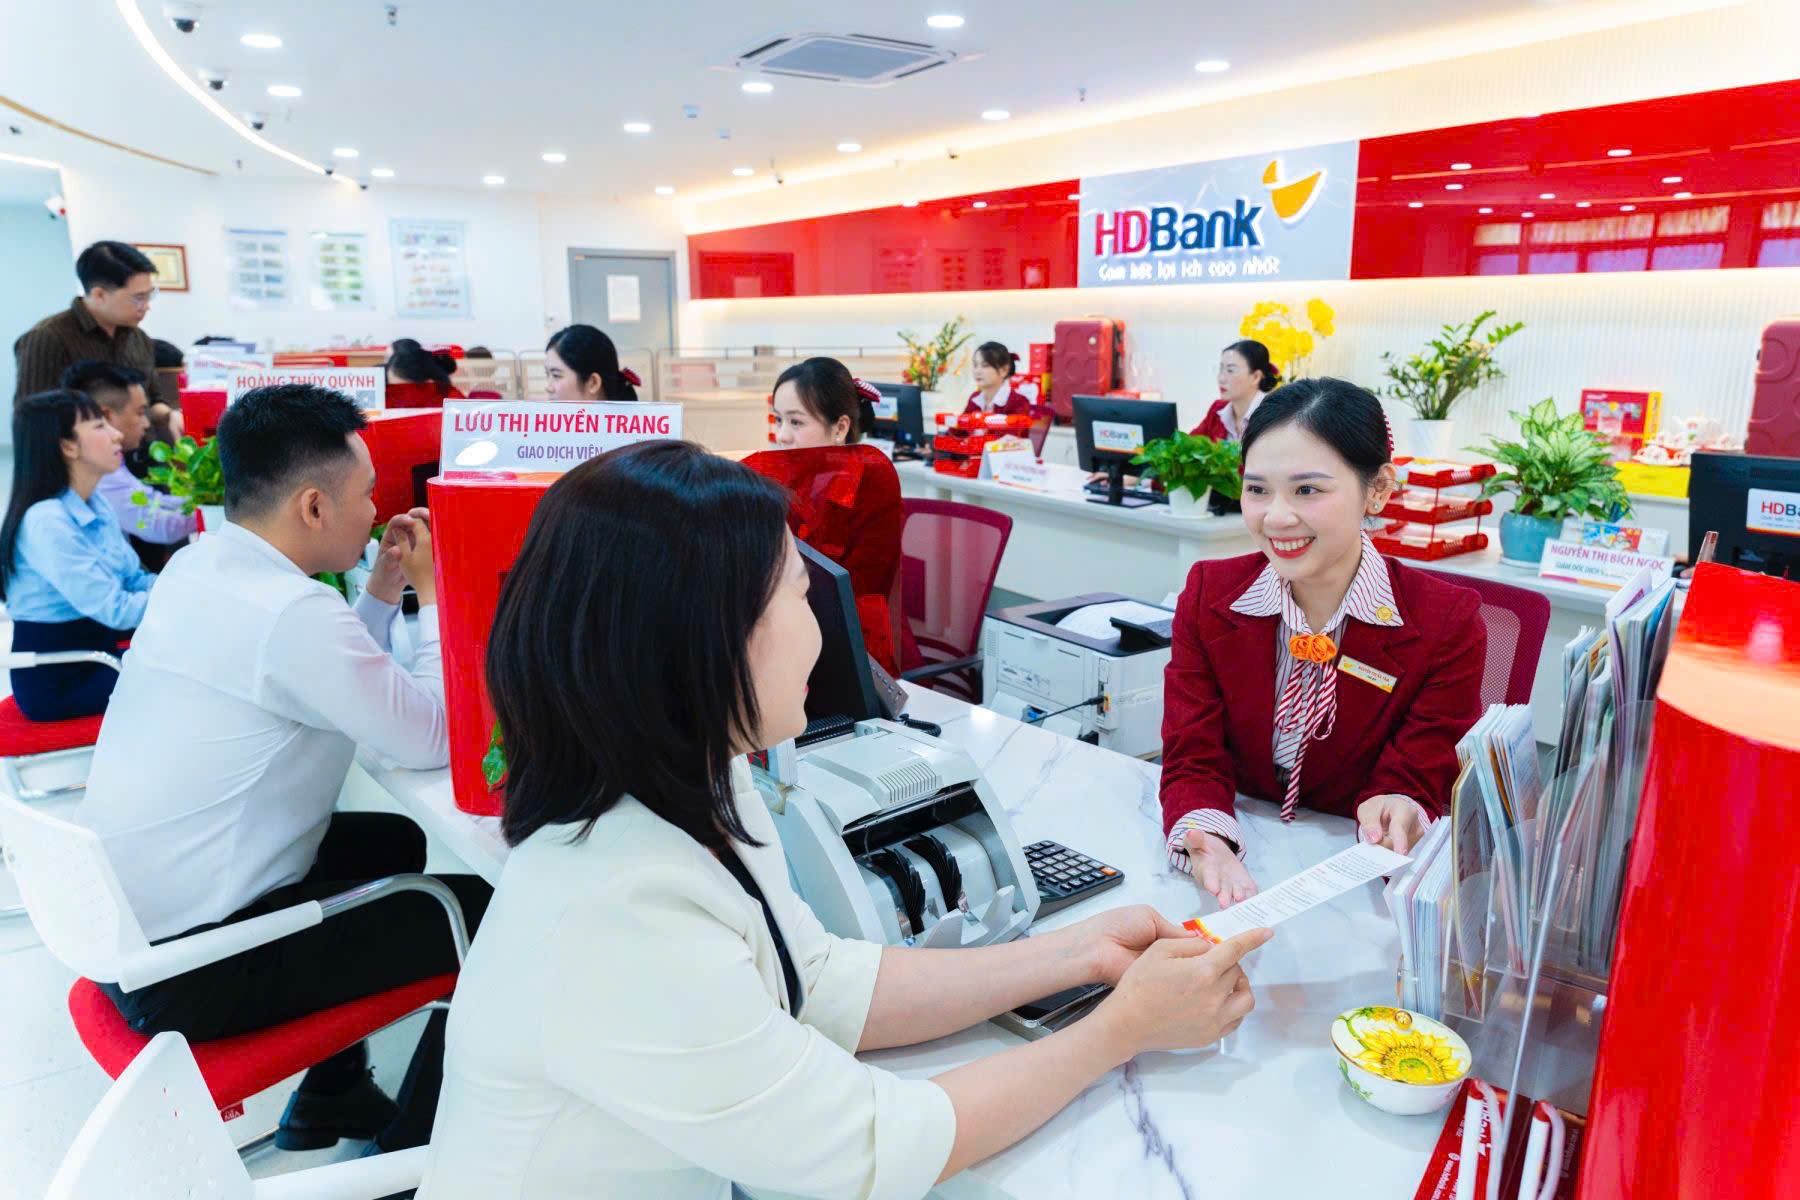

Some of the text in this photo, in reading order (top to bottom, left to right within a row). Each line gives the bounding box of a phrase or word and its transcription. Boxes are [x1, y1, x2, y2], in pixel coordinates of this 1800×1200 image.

[1095, 199, 1264, 256] HDBank
[237, 373, 285, 388] HOÀNG
[328, 372, 376, 389] QUỲNH
[454, 408, 670, 438] LƯU THỊ HUYỀN TRANG
[517, 443, 603, 463] GIAO DỊCH VIÊN
[1591, 550, 1609, 564] THỊ
[1610, 552, 1634, 566] BÍCH
